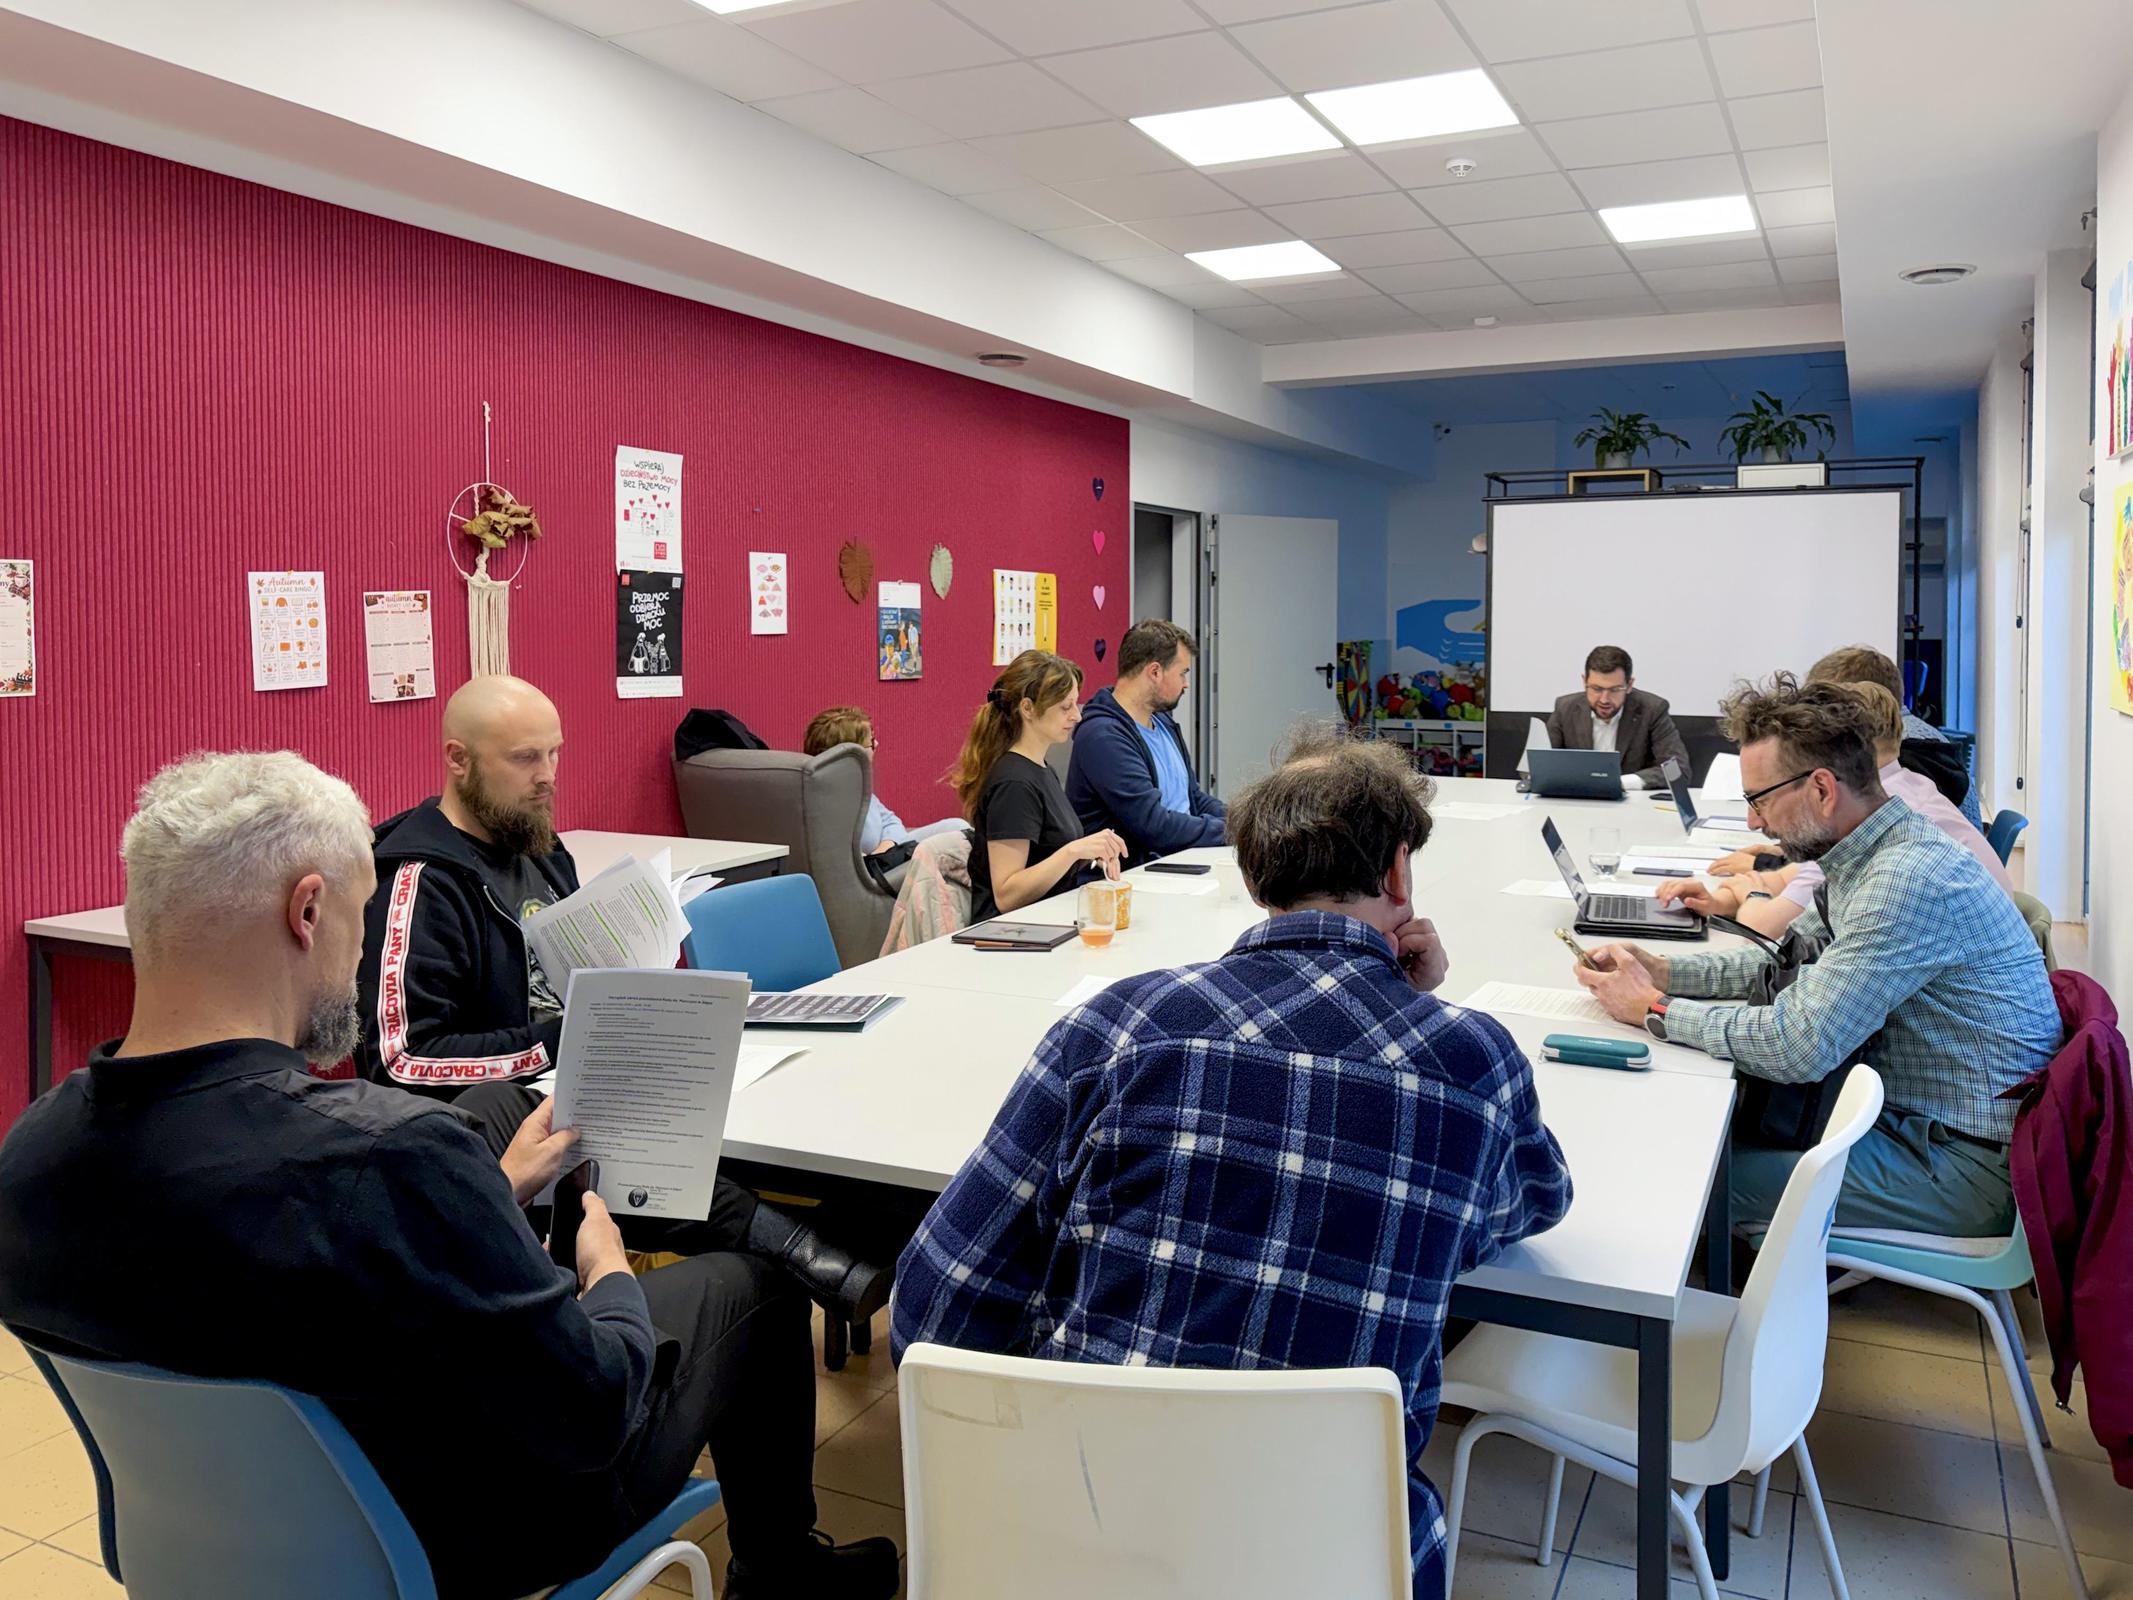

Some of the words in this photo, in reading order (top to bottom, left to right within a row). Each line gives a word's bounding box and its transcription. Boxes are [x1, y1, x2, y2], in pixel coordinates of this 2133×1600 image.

[632, 592, 670, 604] PRZEMOC
[643, 618, 662, 631] MOC
[387, 927, 403, 967] PANY
[385, 971, 400, 1041] CRACOVIA
[409, 1064, 487, 1079] CRACOVIA
[511, 1052, 543, 1073] PNY
